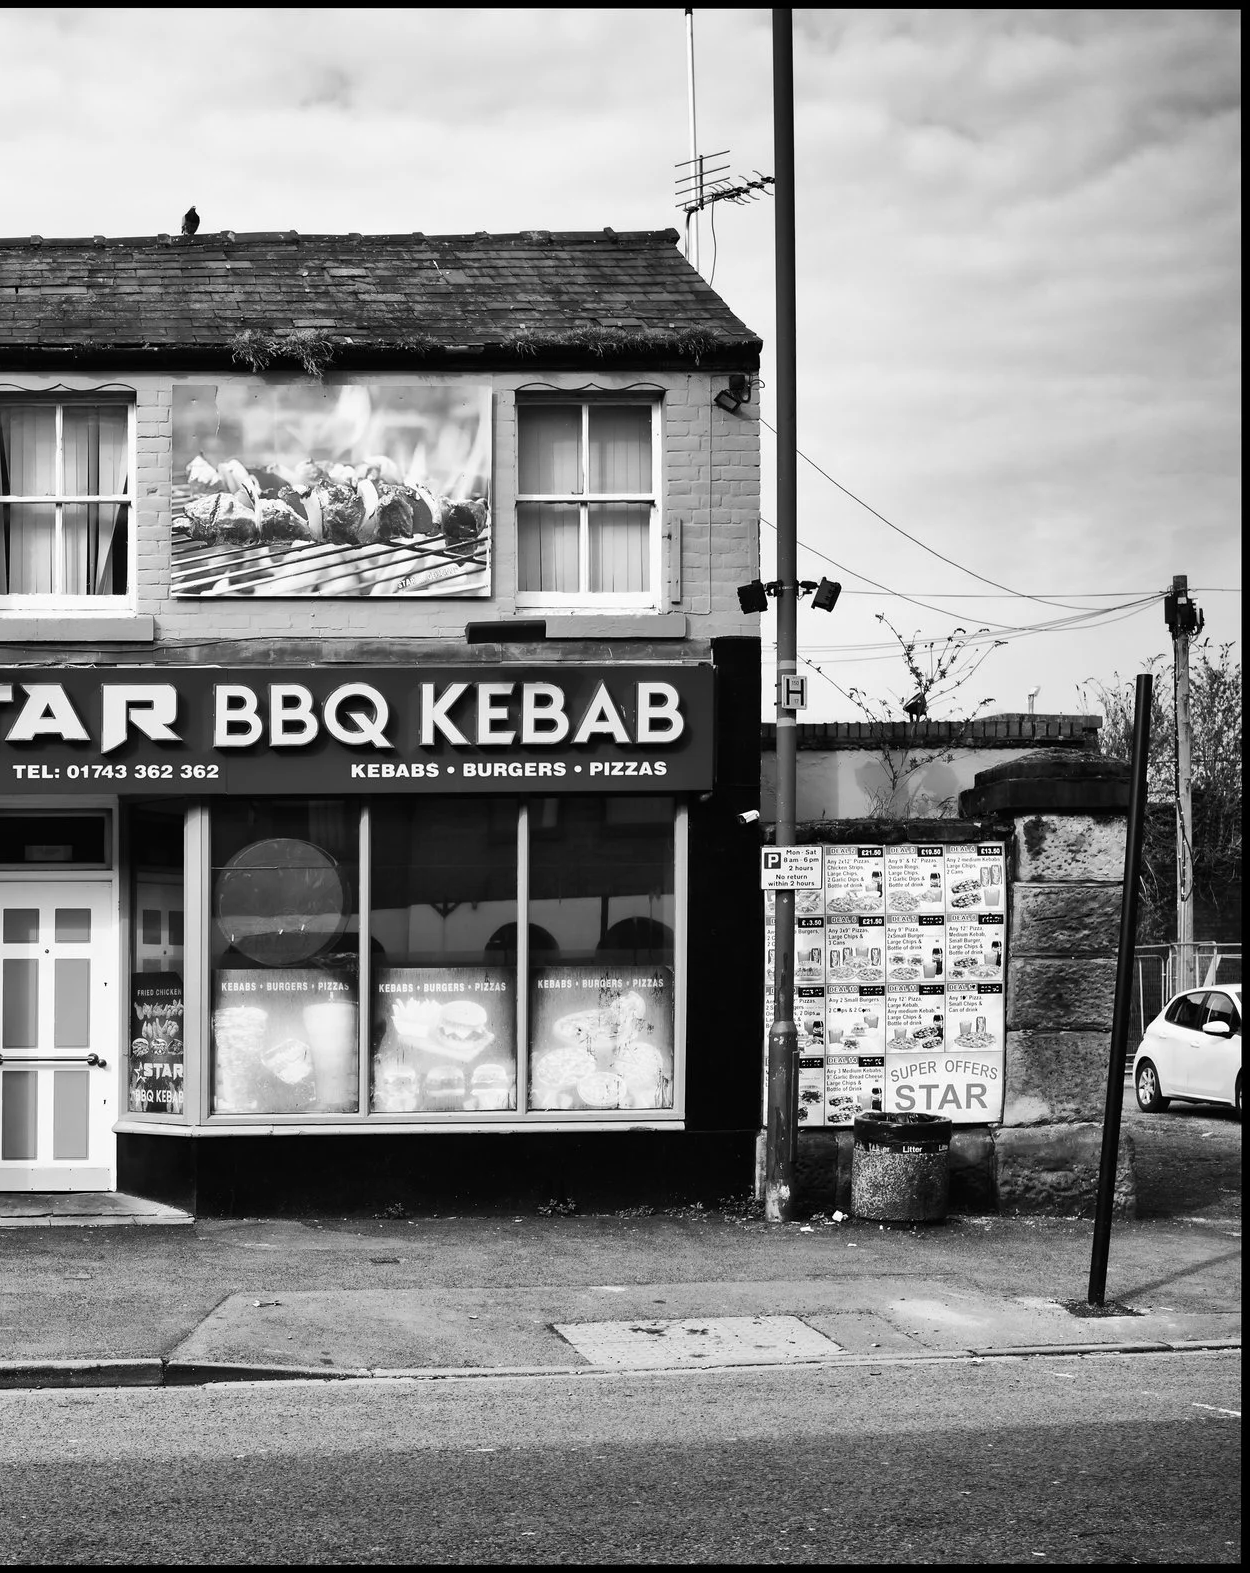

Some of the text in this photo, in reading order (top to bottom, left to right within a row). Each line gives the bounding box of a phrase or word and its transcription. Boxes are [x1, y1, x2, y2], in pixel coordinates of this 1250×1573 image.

[786, 678, 804, 706] H
[213, 682, 395, 749] BBQ
[418, 681, 685, 746] KEBAB
[12, 764, 219, 779] TEL: 01743 362 362
[351, 761, 667, 778] KEBABS BURGERS PIZZAS
[767, 853, 780, 868] P
[221, 981, 350, 991] KEBABS BURGERS PIZZAS
[378, 982, 506, 993] KEBABS BURGERS PIZZAS
[537, 978, 664, 989] KEBABS BURGERS PIZZAS
[155, 988, 182, 996] CHICKEN
[143, 1062, 184, 1080] STAR
[890, 1059, 998, 1082] SUPER OFFERS
[134, 1089, 184, 1103] BBQ KEBAB
[894, 1083, 988, 1111] STAR
[902, 1145, 923, 1153] Litter
